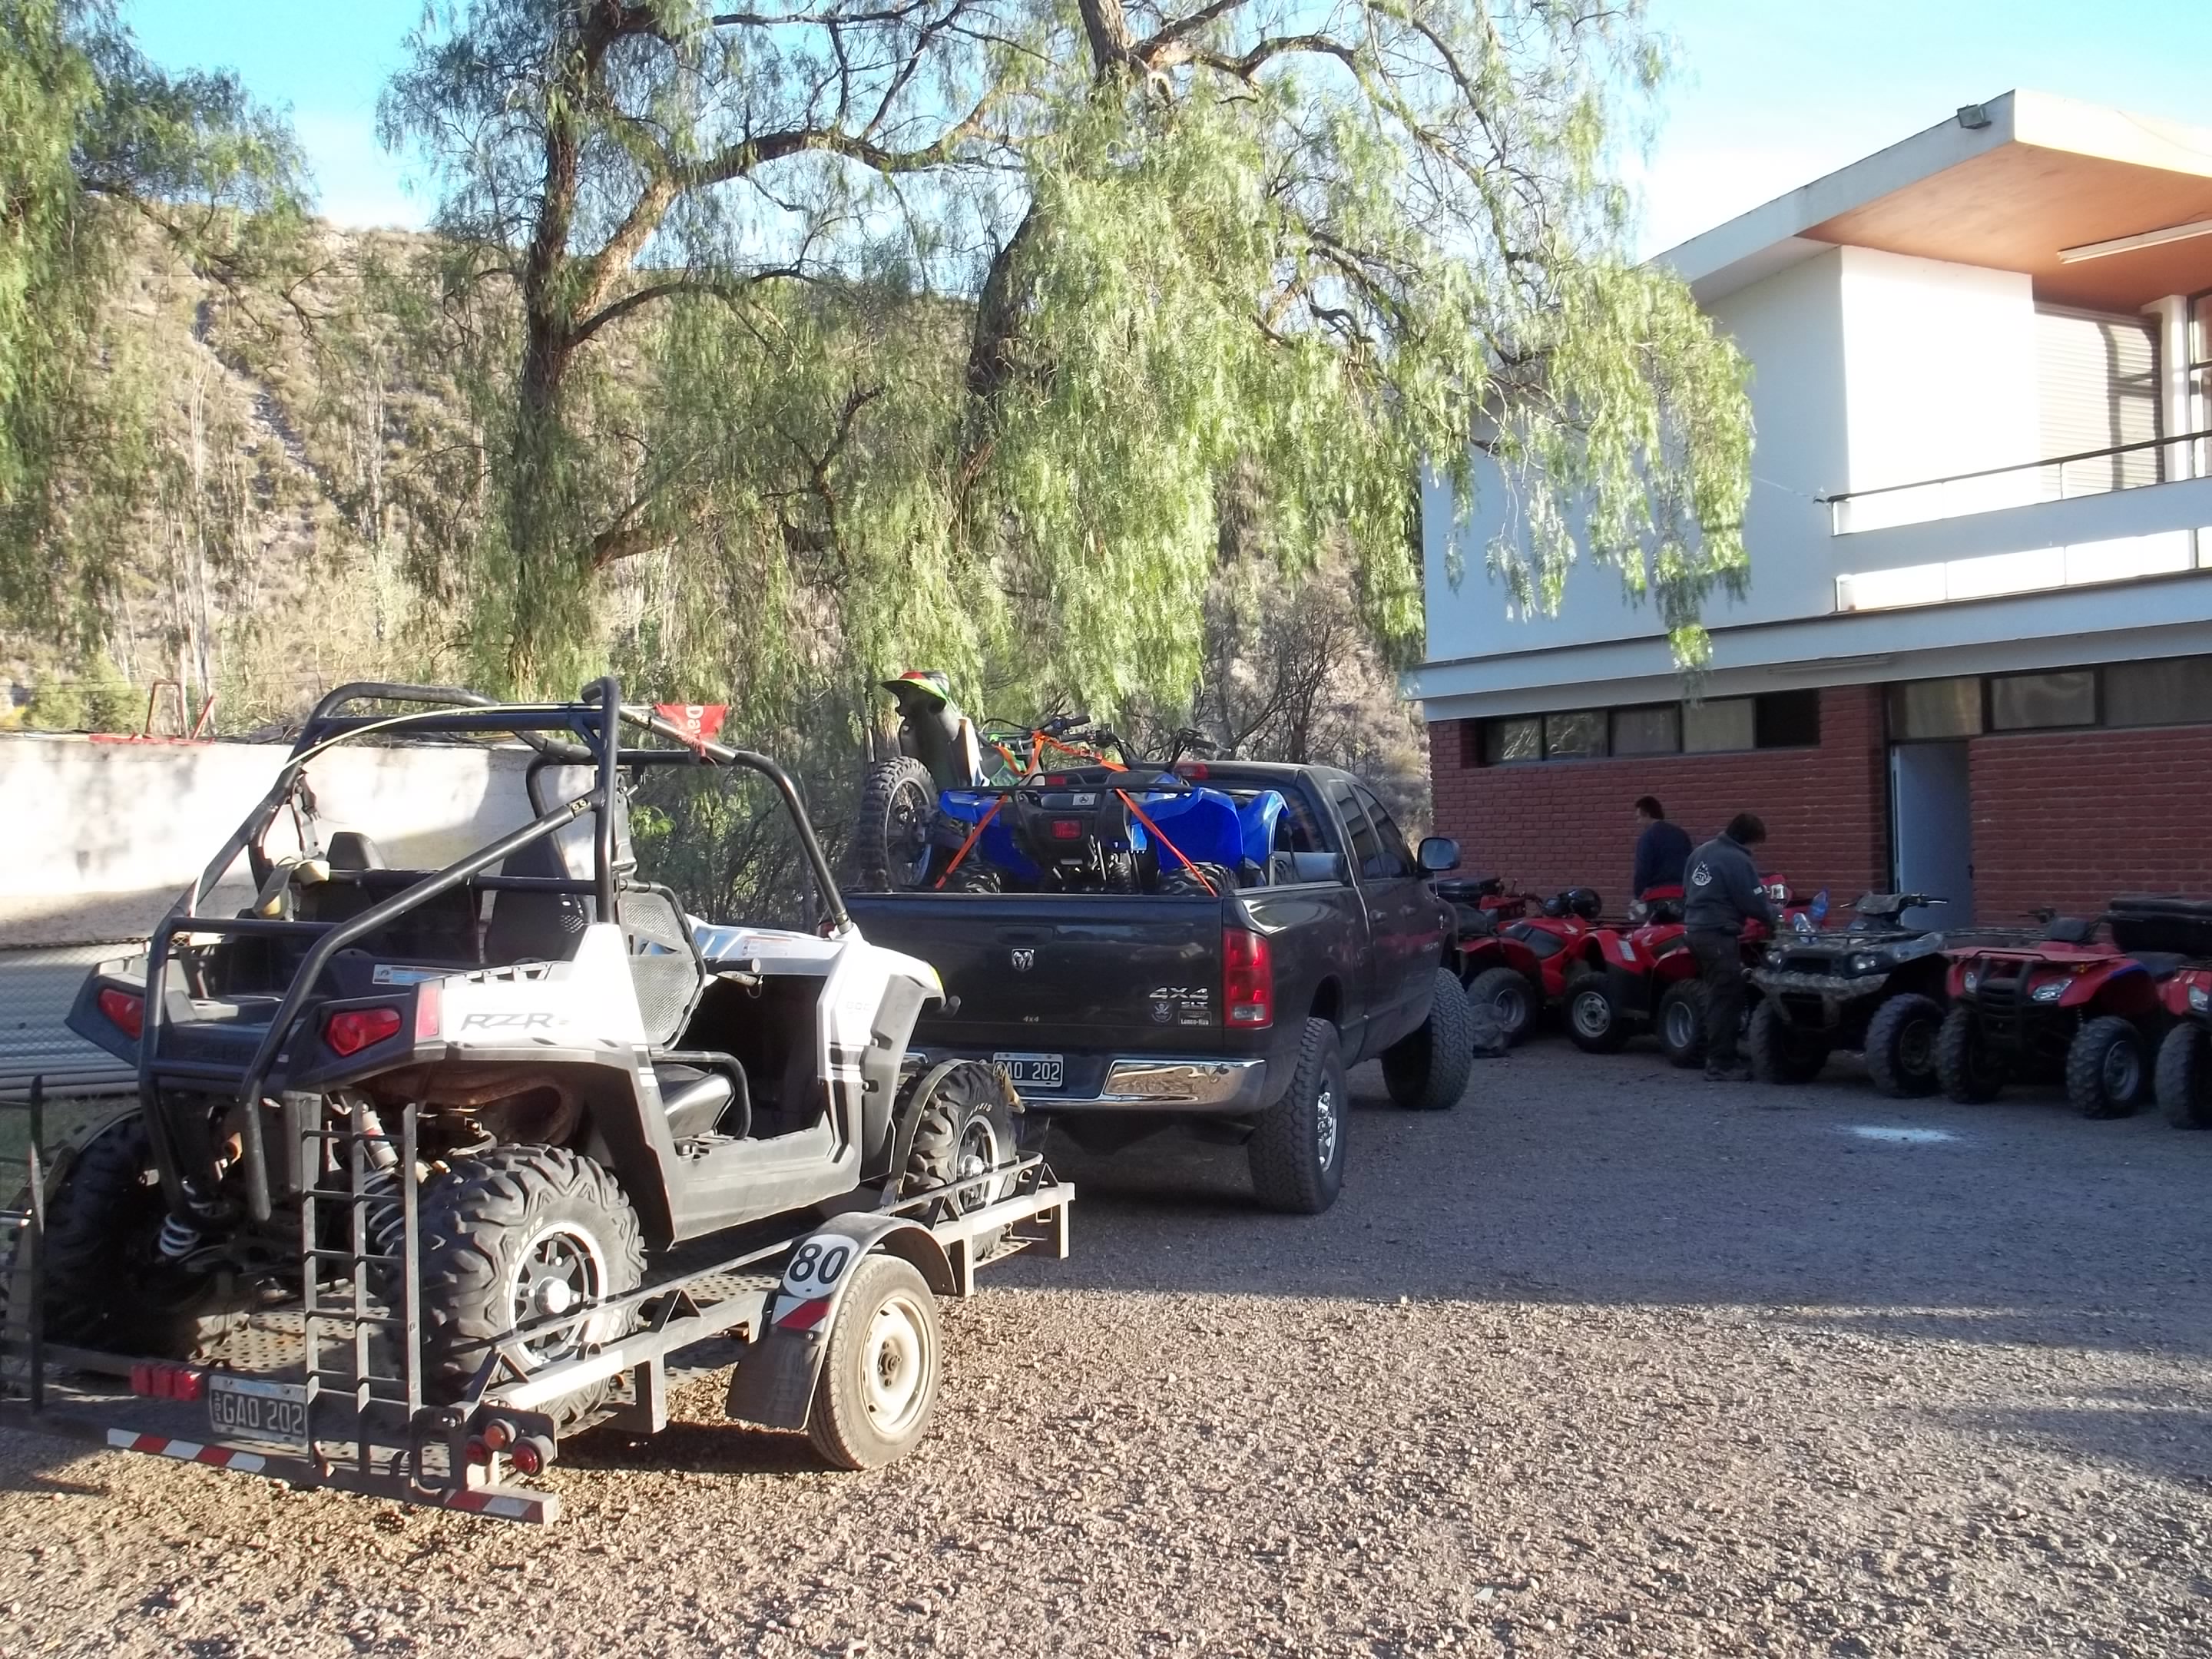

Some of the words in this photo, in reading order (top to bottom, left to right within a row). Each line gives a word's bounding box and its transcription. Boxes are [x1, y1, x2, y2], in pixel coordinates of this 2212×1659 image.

[460, 1012, 555, 1031] RZR
[1031, 1061, 1060, 1081] 202
[789, 1243, 850, 1285] 80
[267, 1399, 305, 1435] 202
